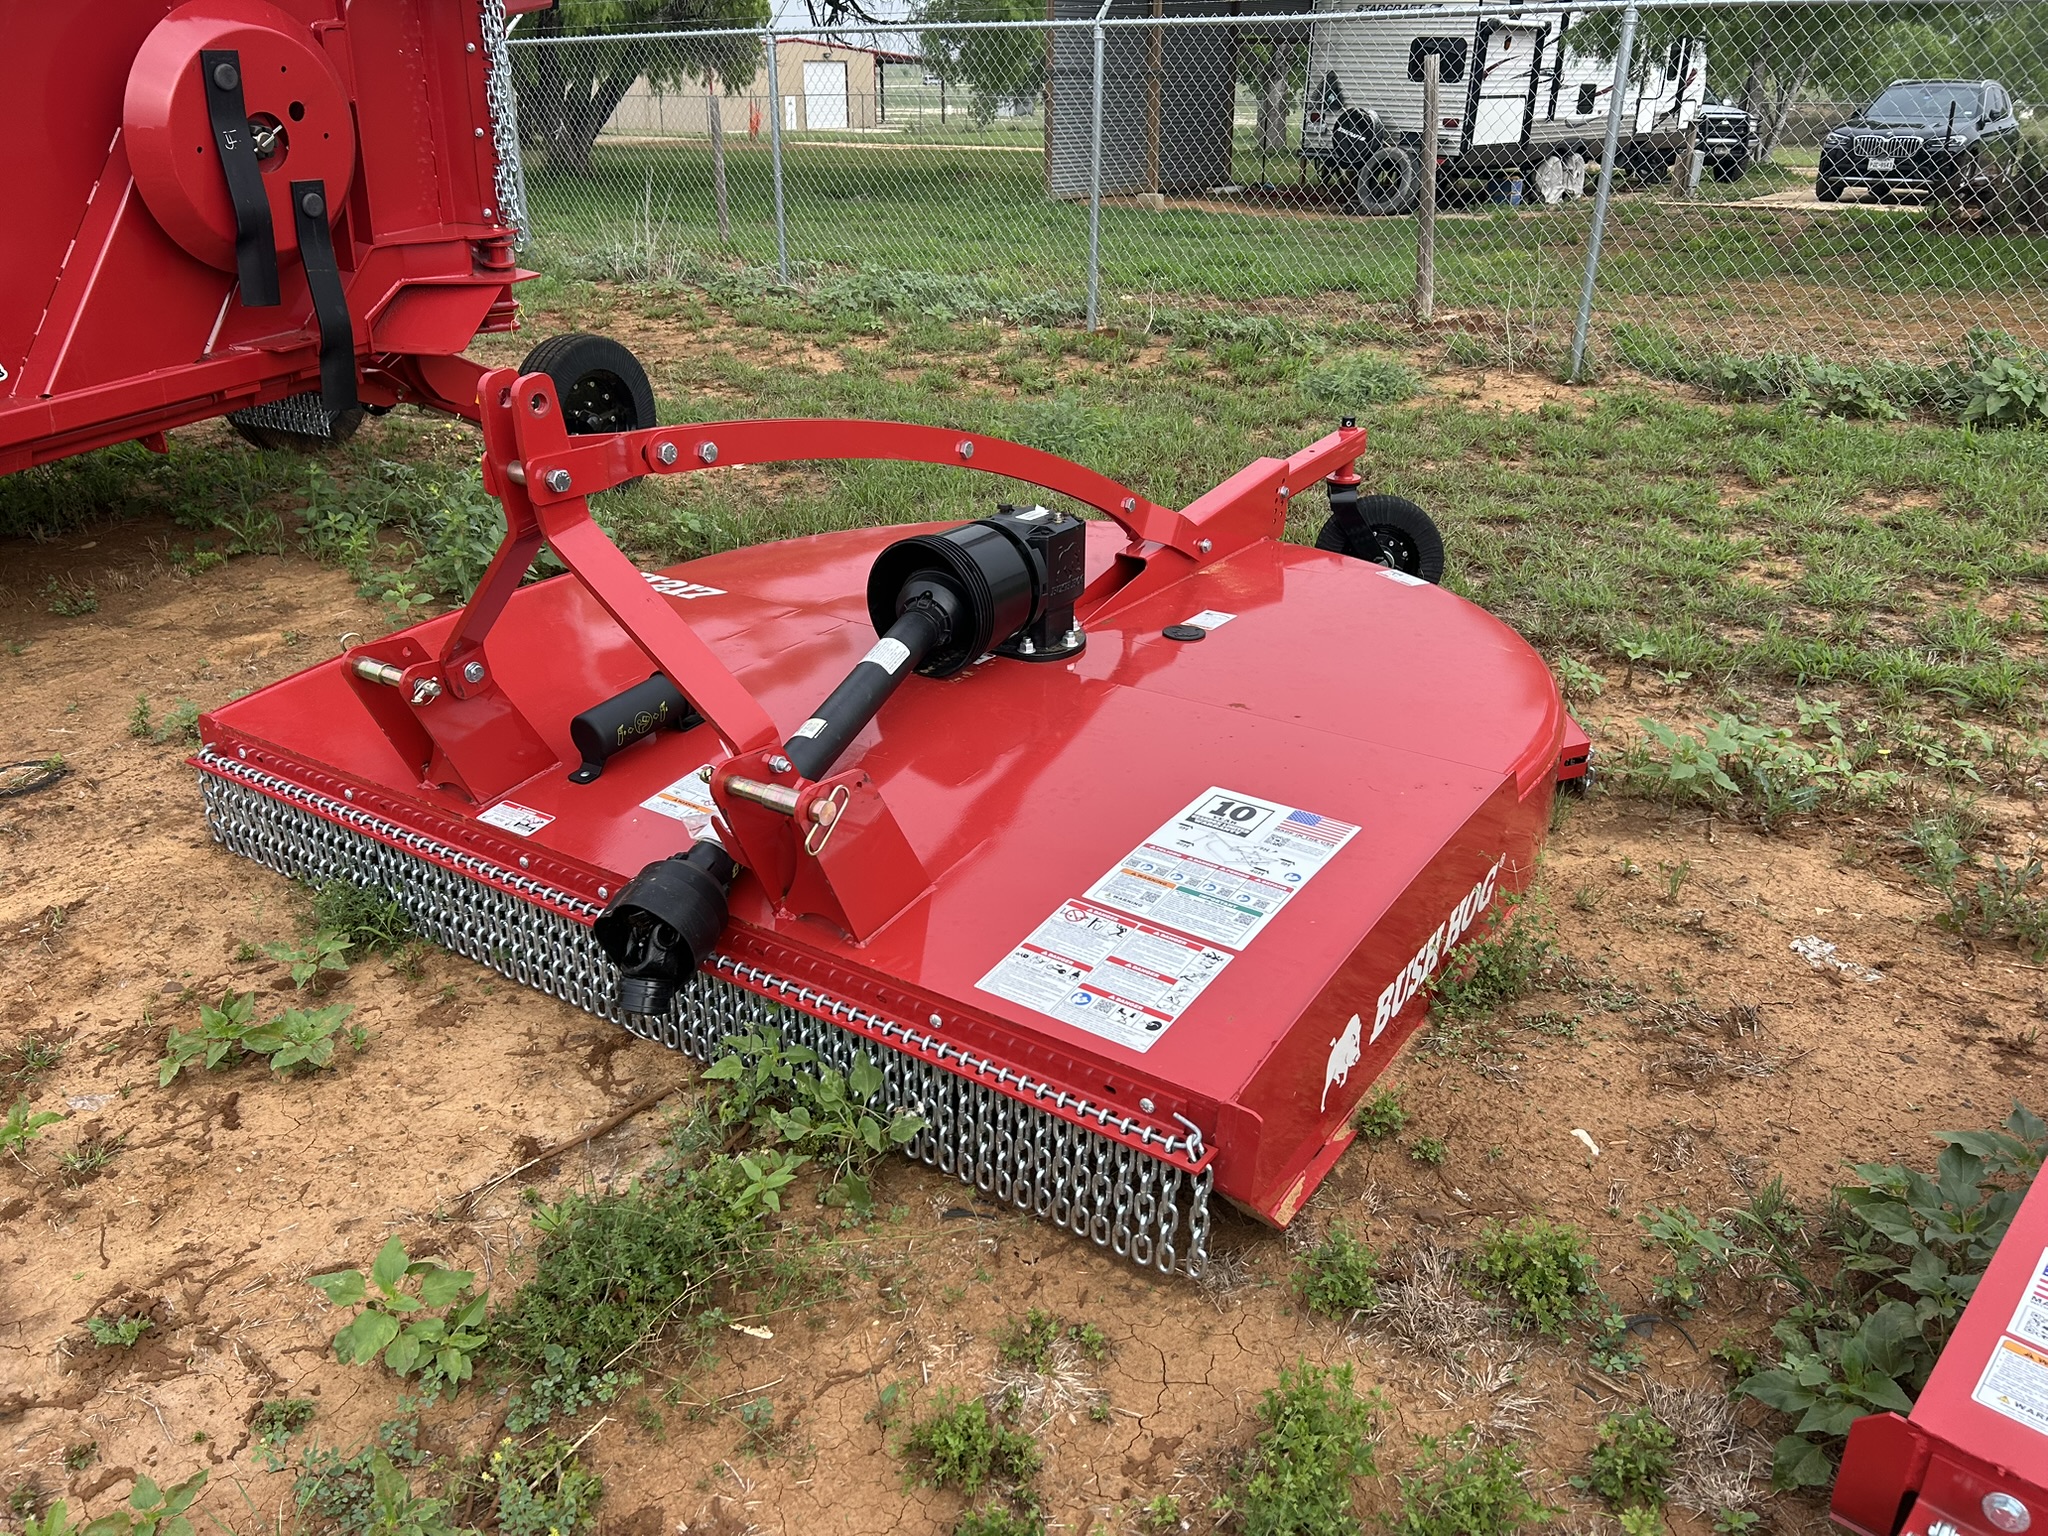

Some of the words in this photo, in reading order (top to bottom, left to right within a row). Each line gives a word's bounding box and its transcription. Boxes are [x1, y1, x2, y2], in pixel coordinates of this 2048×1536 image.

[1356, 3, 1426, 13] STARCRAFT
[1209, 801, 1257, 821] 10
[1137, 873, 1168, 885] WARNING
[1111, 894, 1144, 907] WARNING
[1197, 893, 1238, 909] IMPORTANT
[1092, 910, 1119, 921] DANGER
[1159, 933, 1188, 945] DANGER
[1047, 952, 1075, 965] DANGER
[1369, 921, 1446, 1046] BUSH
[1442, 861, 1499, 957] HOG
[1130, 965, 1160, 978] DANGER
[1114, 997, 1144, 1010] DANGER
